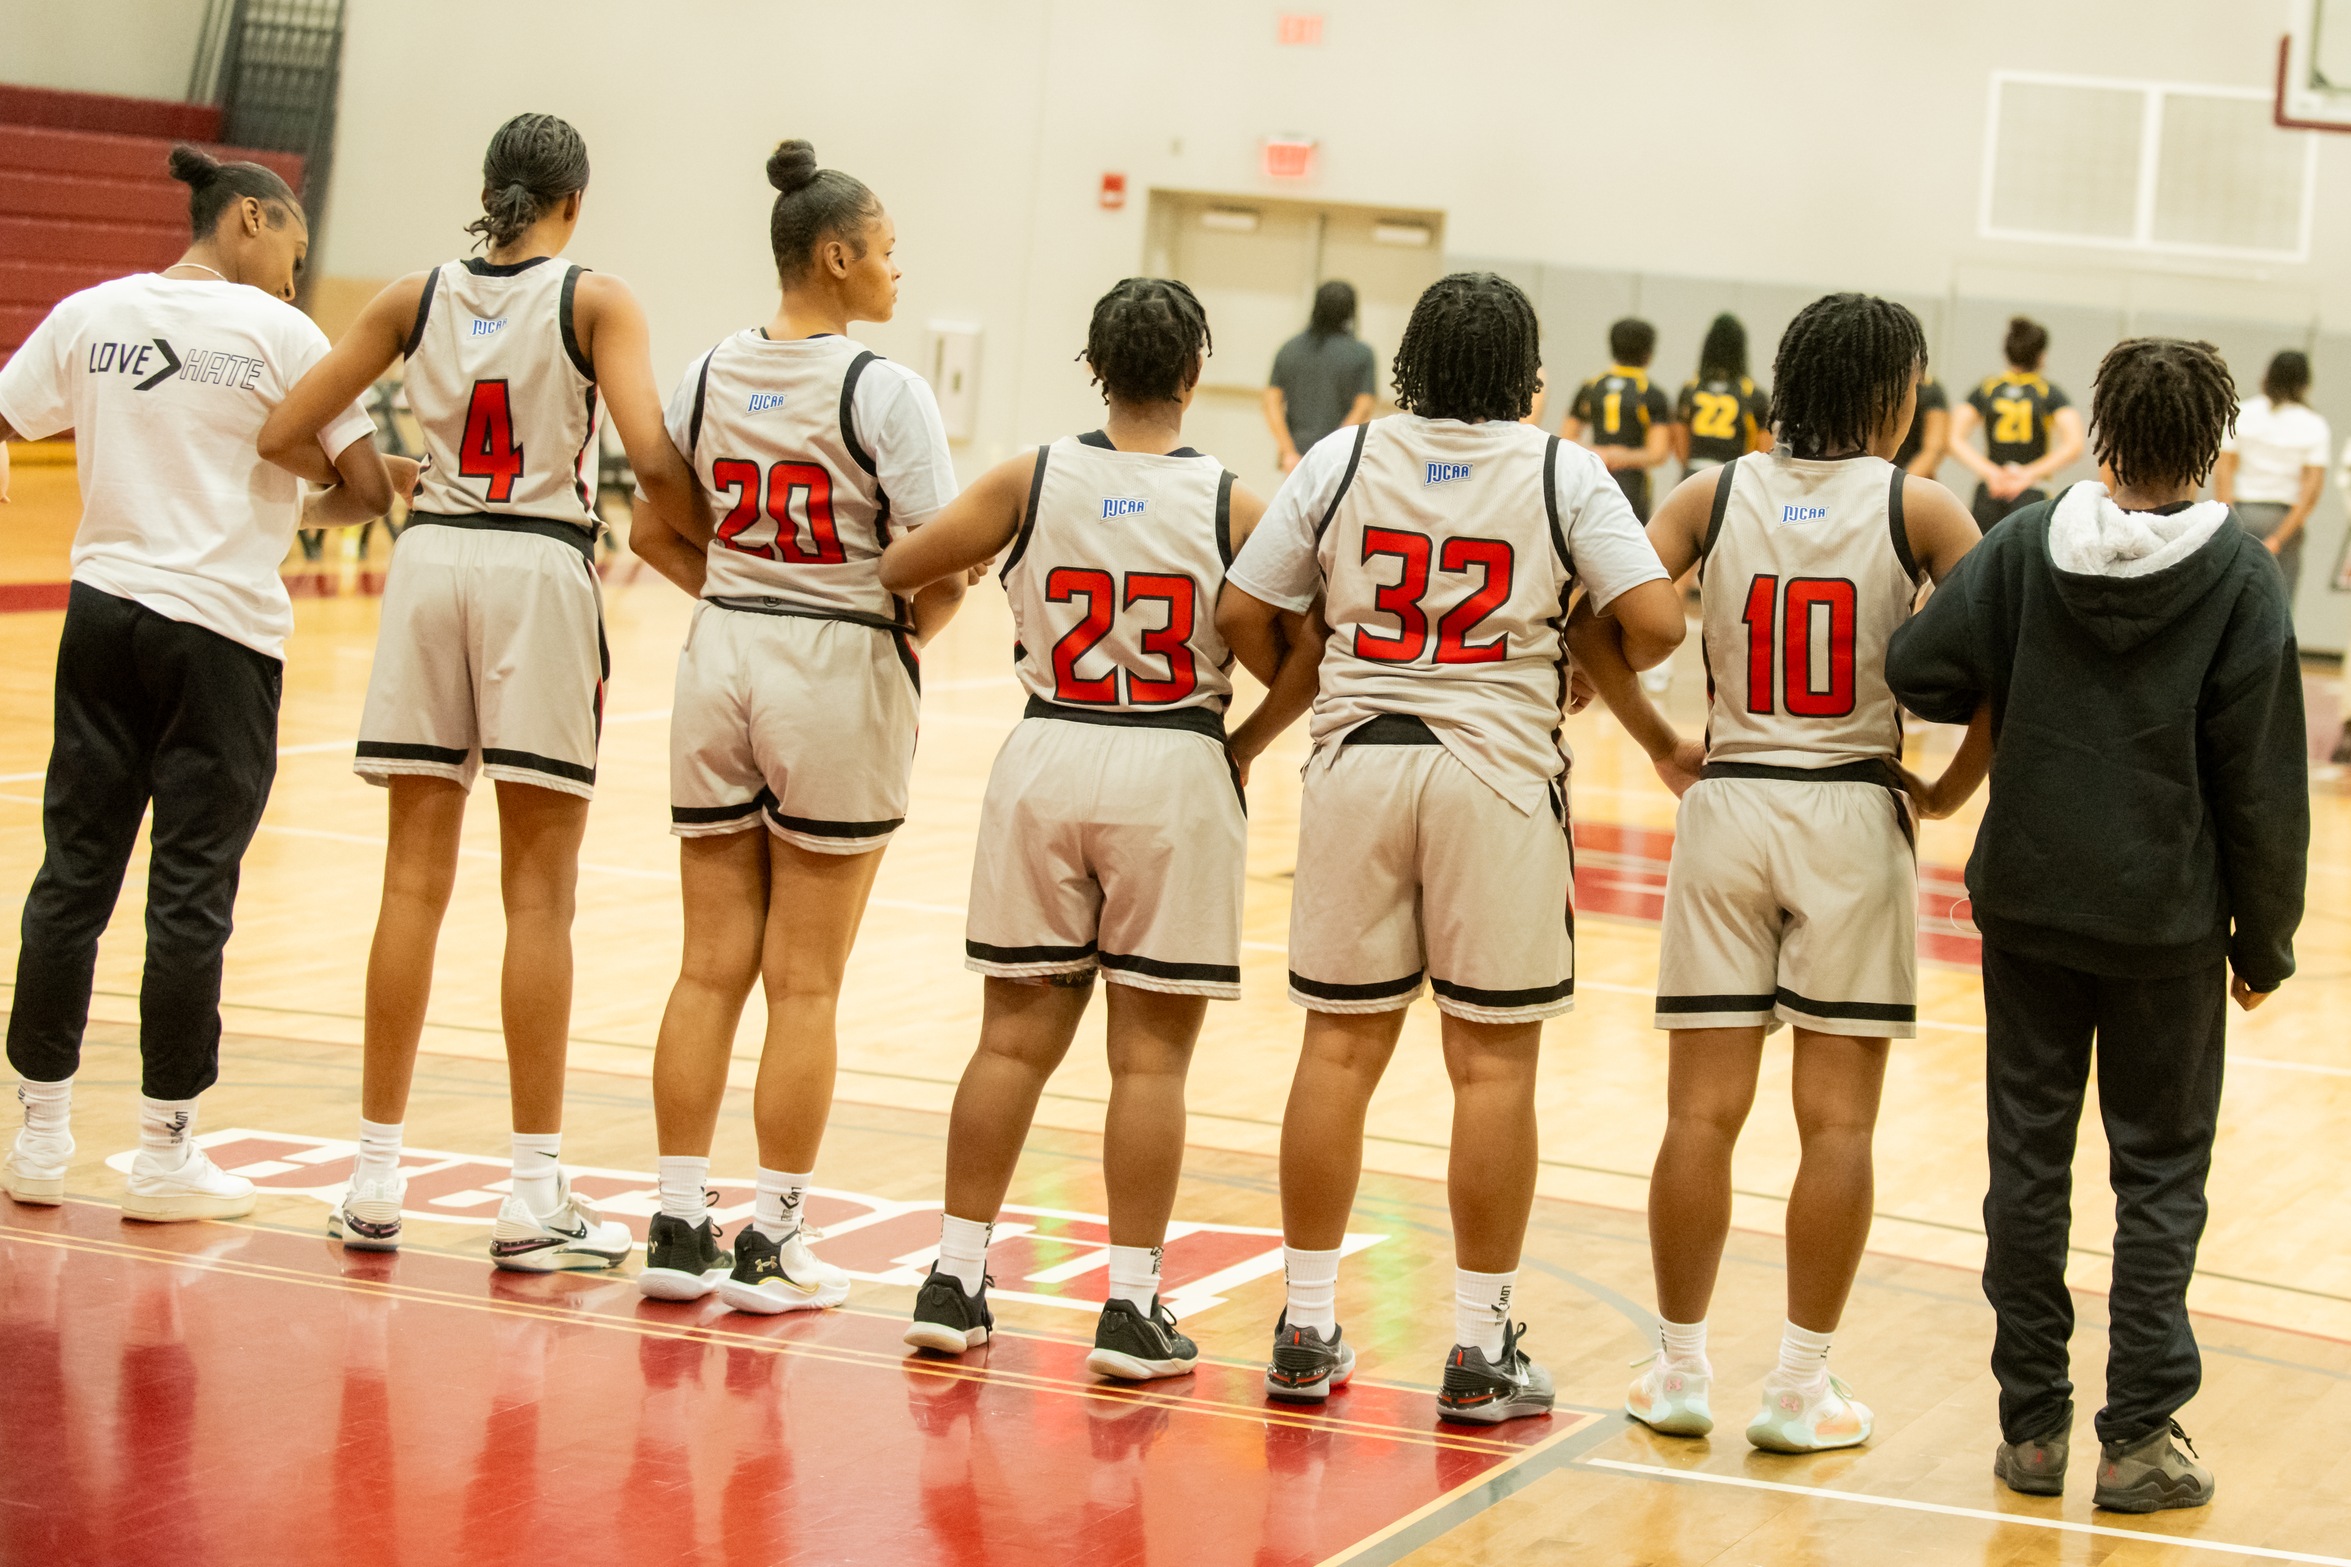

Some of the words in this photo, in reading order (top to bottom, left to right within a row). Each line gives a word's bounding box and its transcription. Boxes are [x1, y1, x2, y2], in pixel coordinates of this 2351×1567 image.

[472, 318, 507, 336] NJCAA
[89, 342, 153, 375] LOVE
[180, 349, 264, 390] HATE
[748, 394, 784, 411] NJCAA
[1603, 392, 1621, 434] 1
[1693, 391, 1739, 439] 22
[1993, 398, 2032, 444] 21
[459, 379, 523, 503] 4
[1426, 463, 1469, 484] NJCAA
[713, 457, 847, 564] 20
[1102, 499, 1145, 518] NJCAA
[1782, 505, 1826, 522] NJCAA
[1353, 525, 1515, 664] 32
[1045, 566, 1197, 706] 23
[1741, 573, 1857, 718] 10
